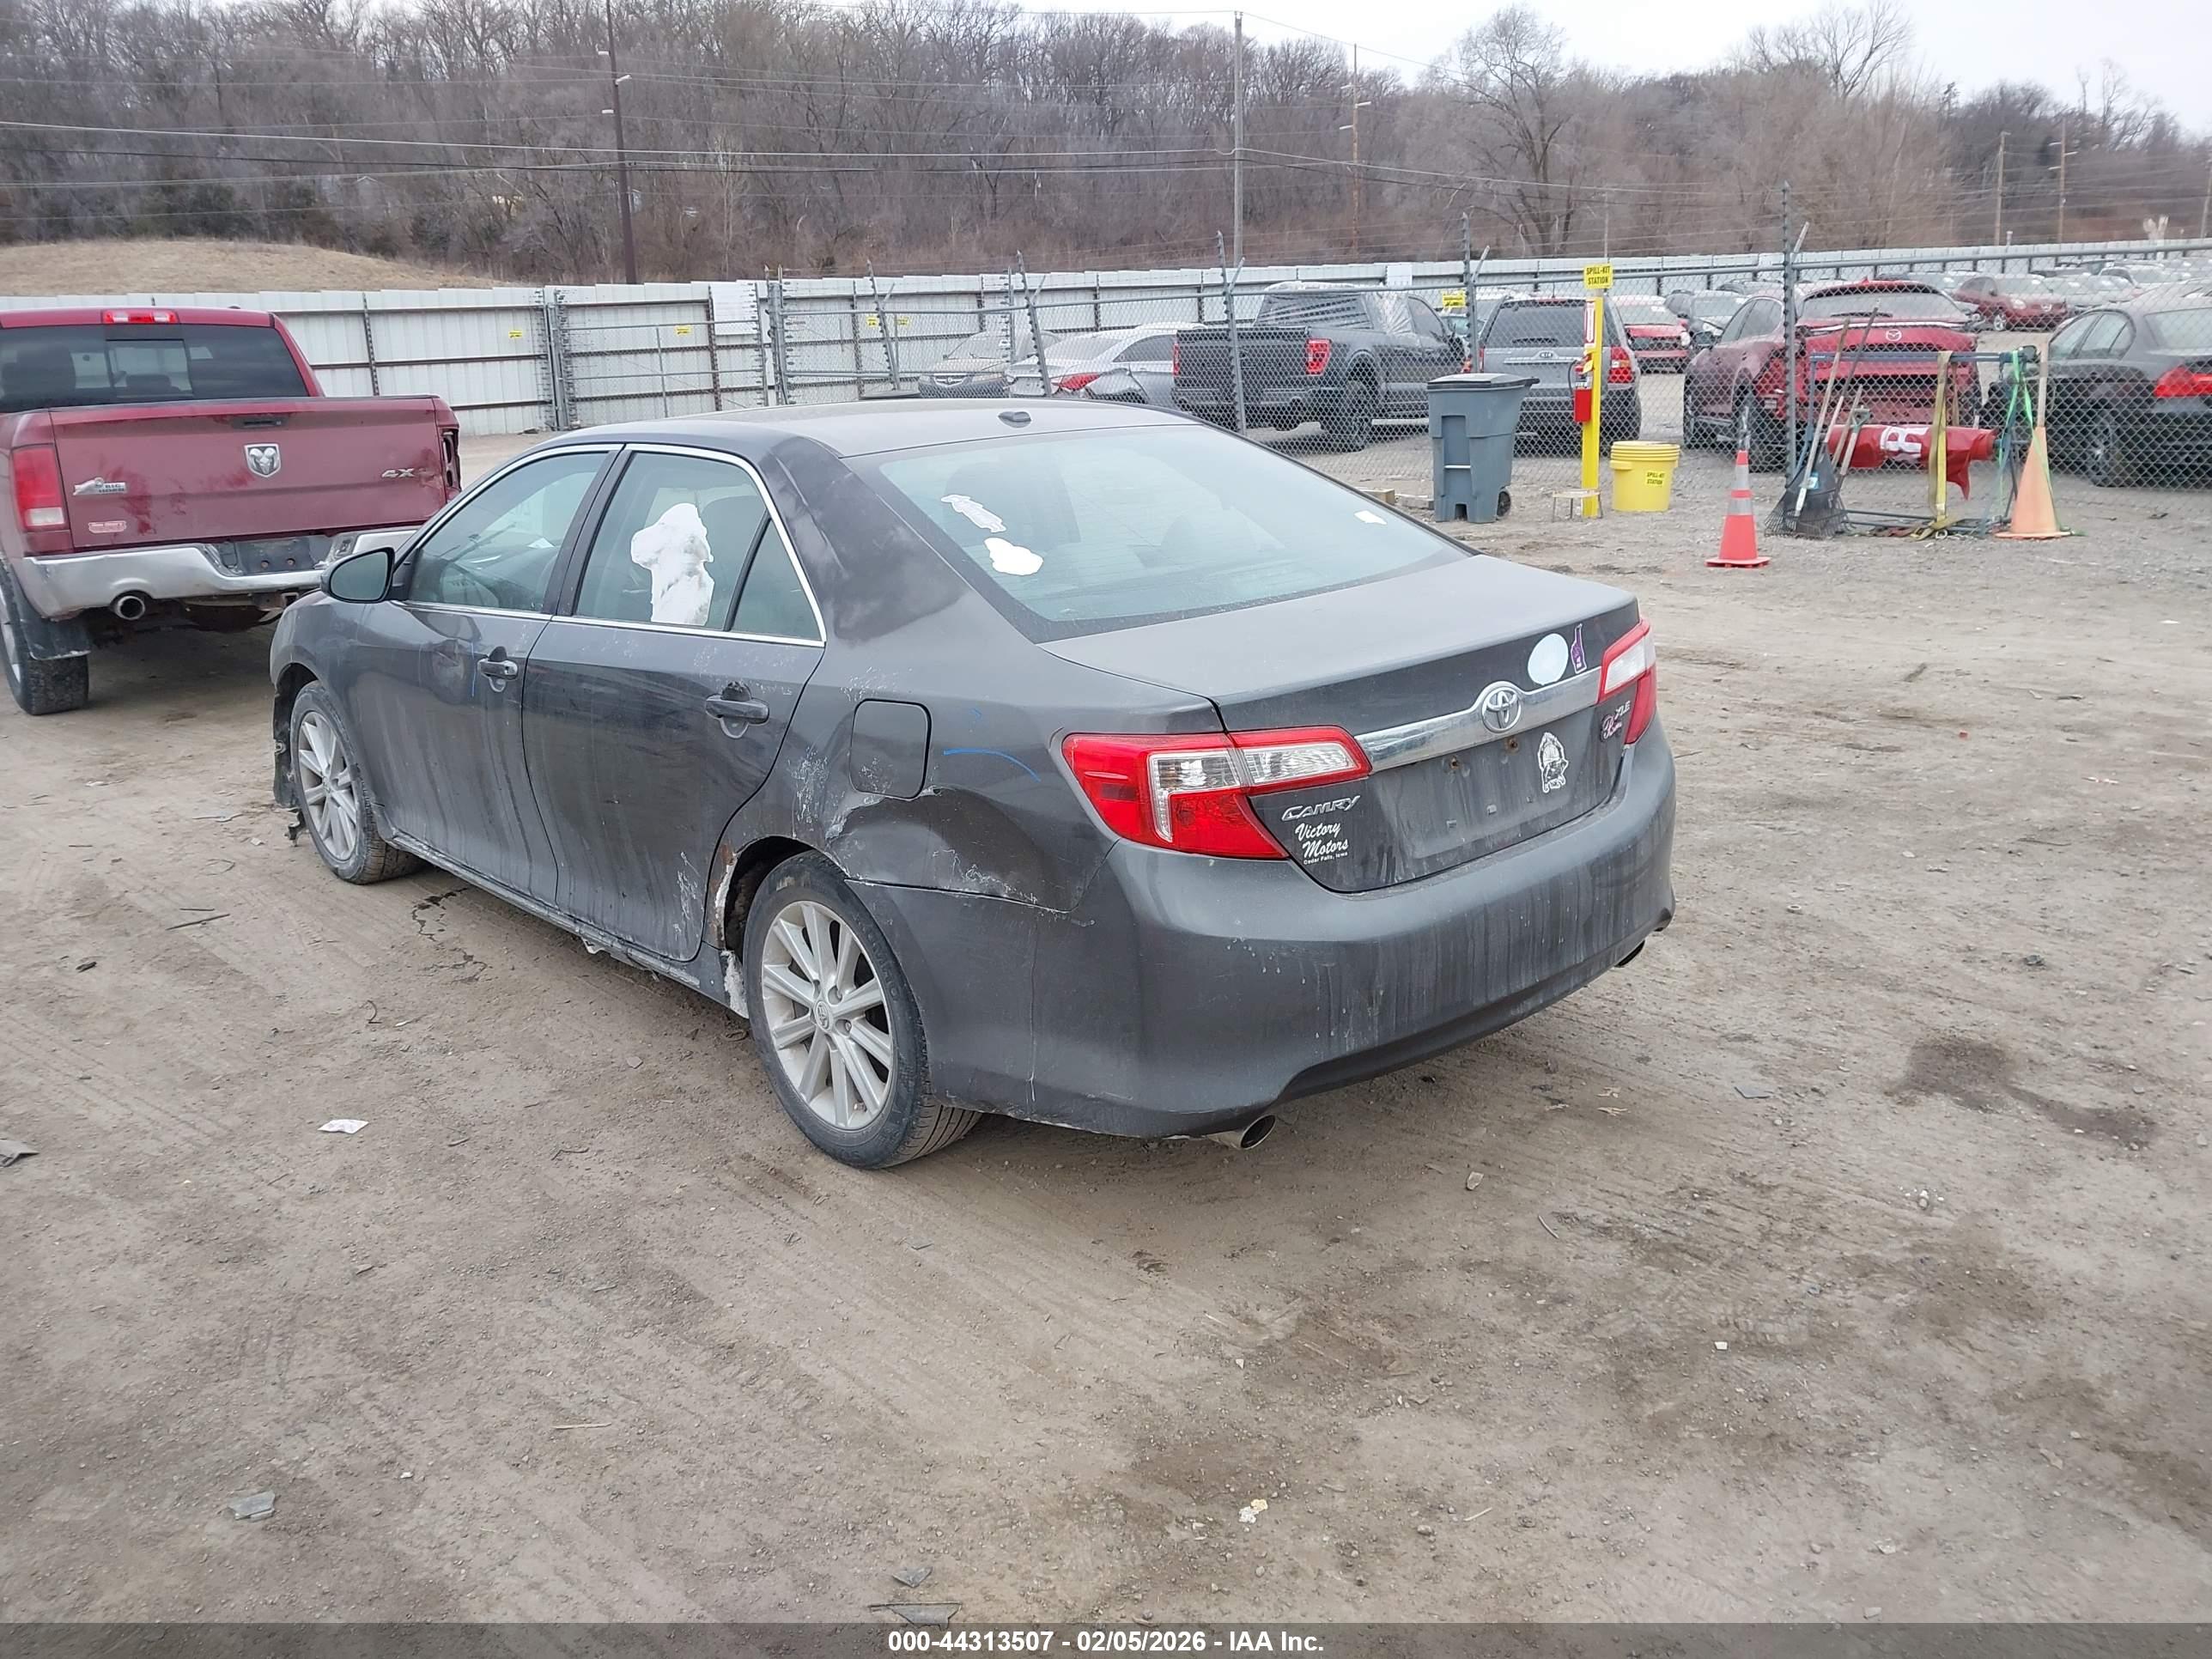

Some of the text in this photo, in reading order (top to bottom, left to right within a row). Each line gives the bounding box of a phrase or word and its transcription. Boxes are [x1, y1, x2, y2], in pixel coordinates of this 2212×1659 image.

[1586, 266, 1610, 275] SPILL-KIT
[1281, 795, 1361, 822] CAMRY
[1295, 823, 1341, 842] Victory
[1302, 839, 1349, 858] Motors
